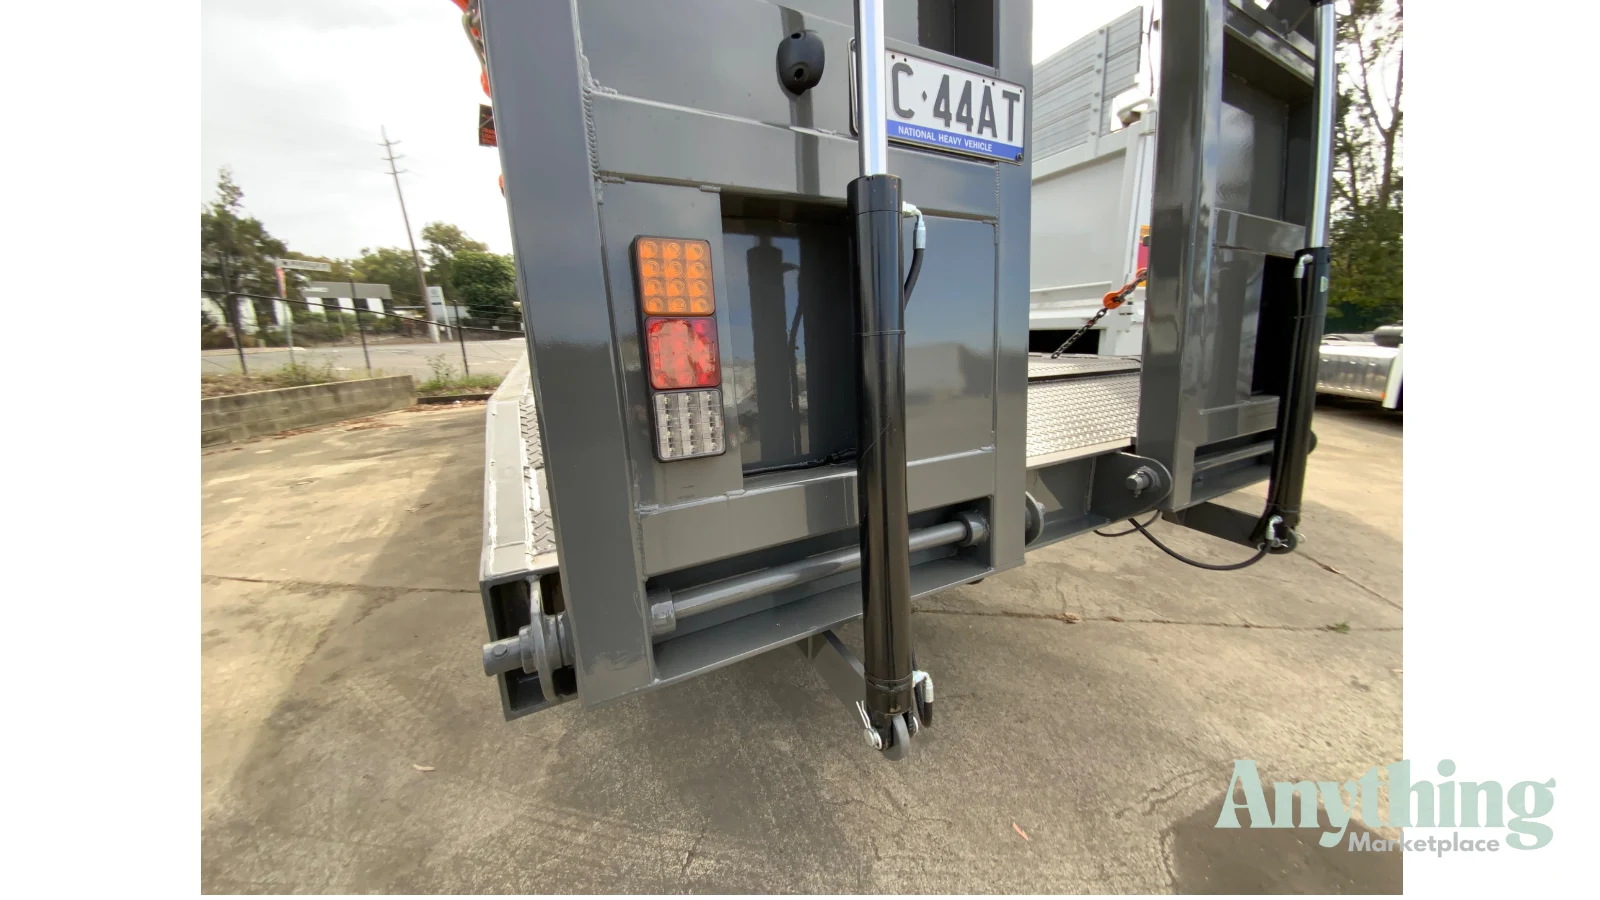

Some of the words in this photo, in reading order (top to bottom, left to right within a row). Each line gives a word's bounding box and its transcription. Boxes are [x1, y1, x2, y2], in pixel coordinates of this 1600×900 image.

[898, 125, 936, 142] NATIONAL
[938, 133, 962, 148] HEAVY
[964, 139, 993, 153] VEHICLE
